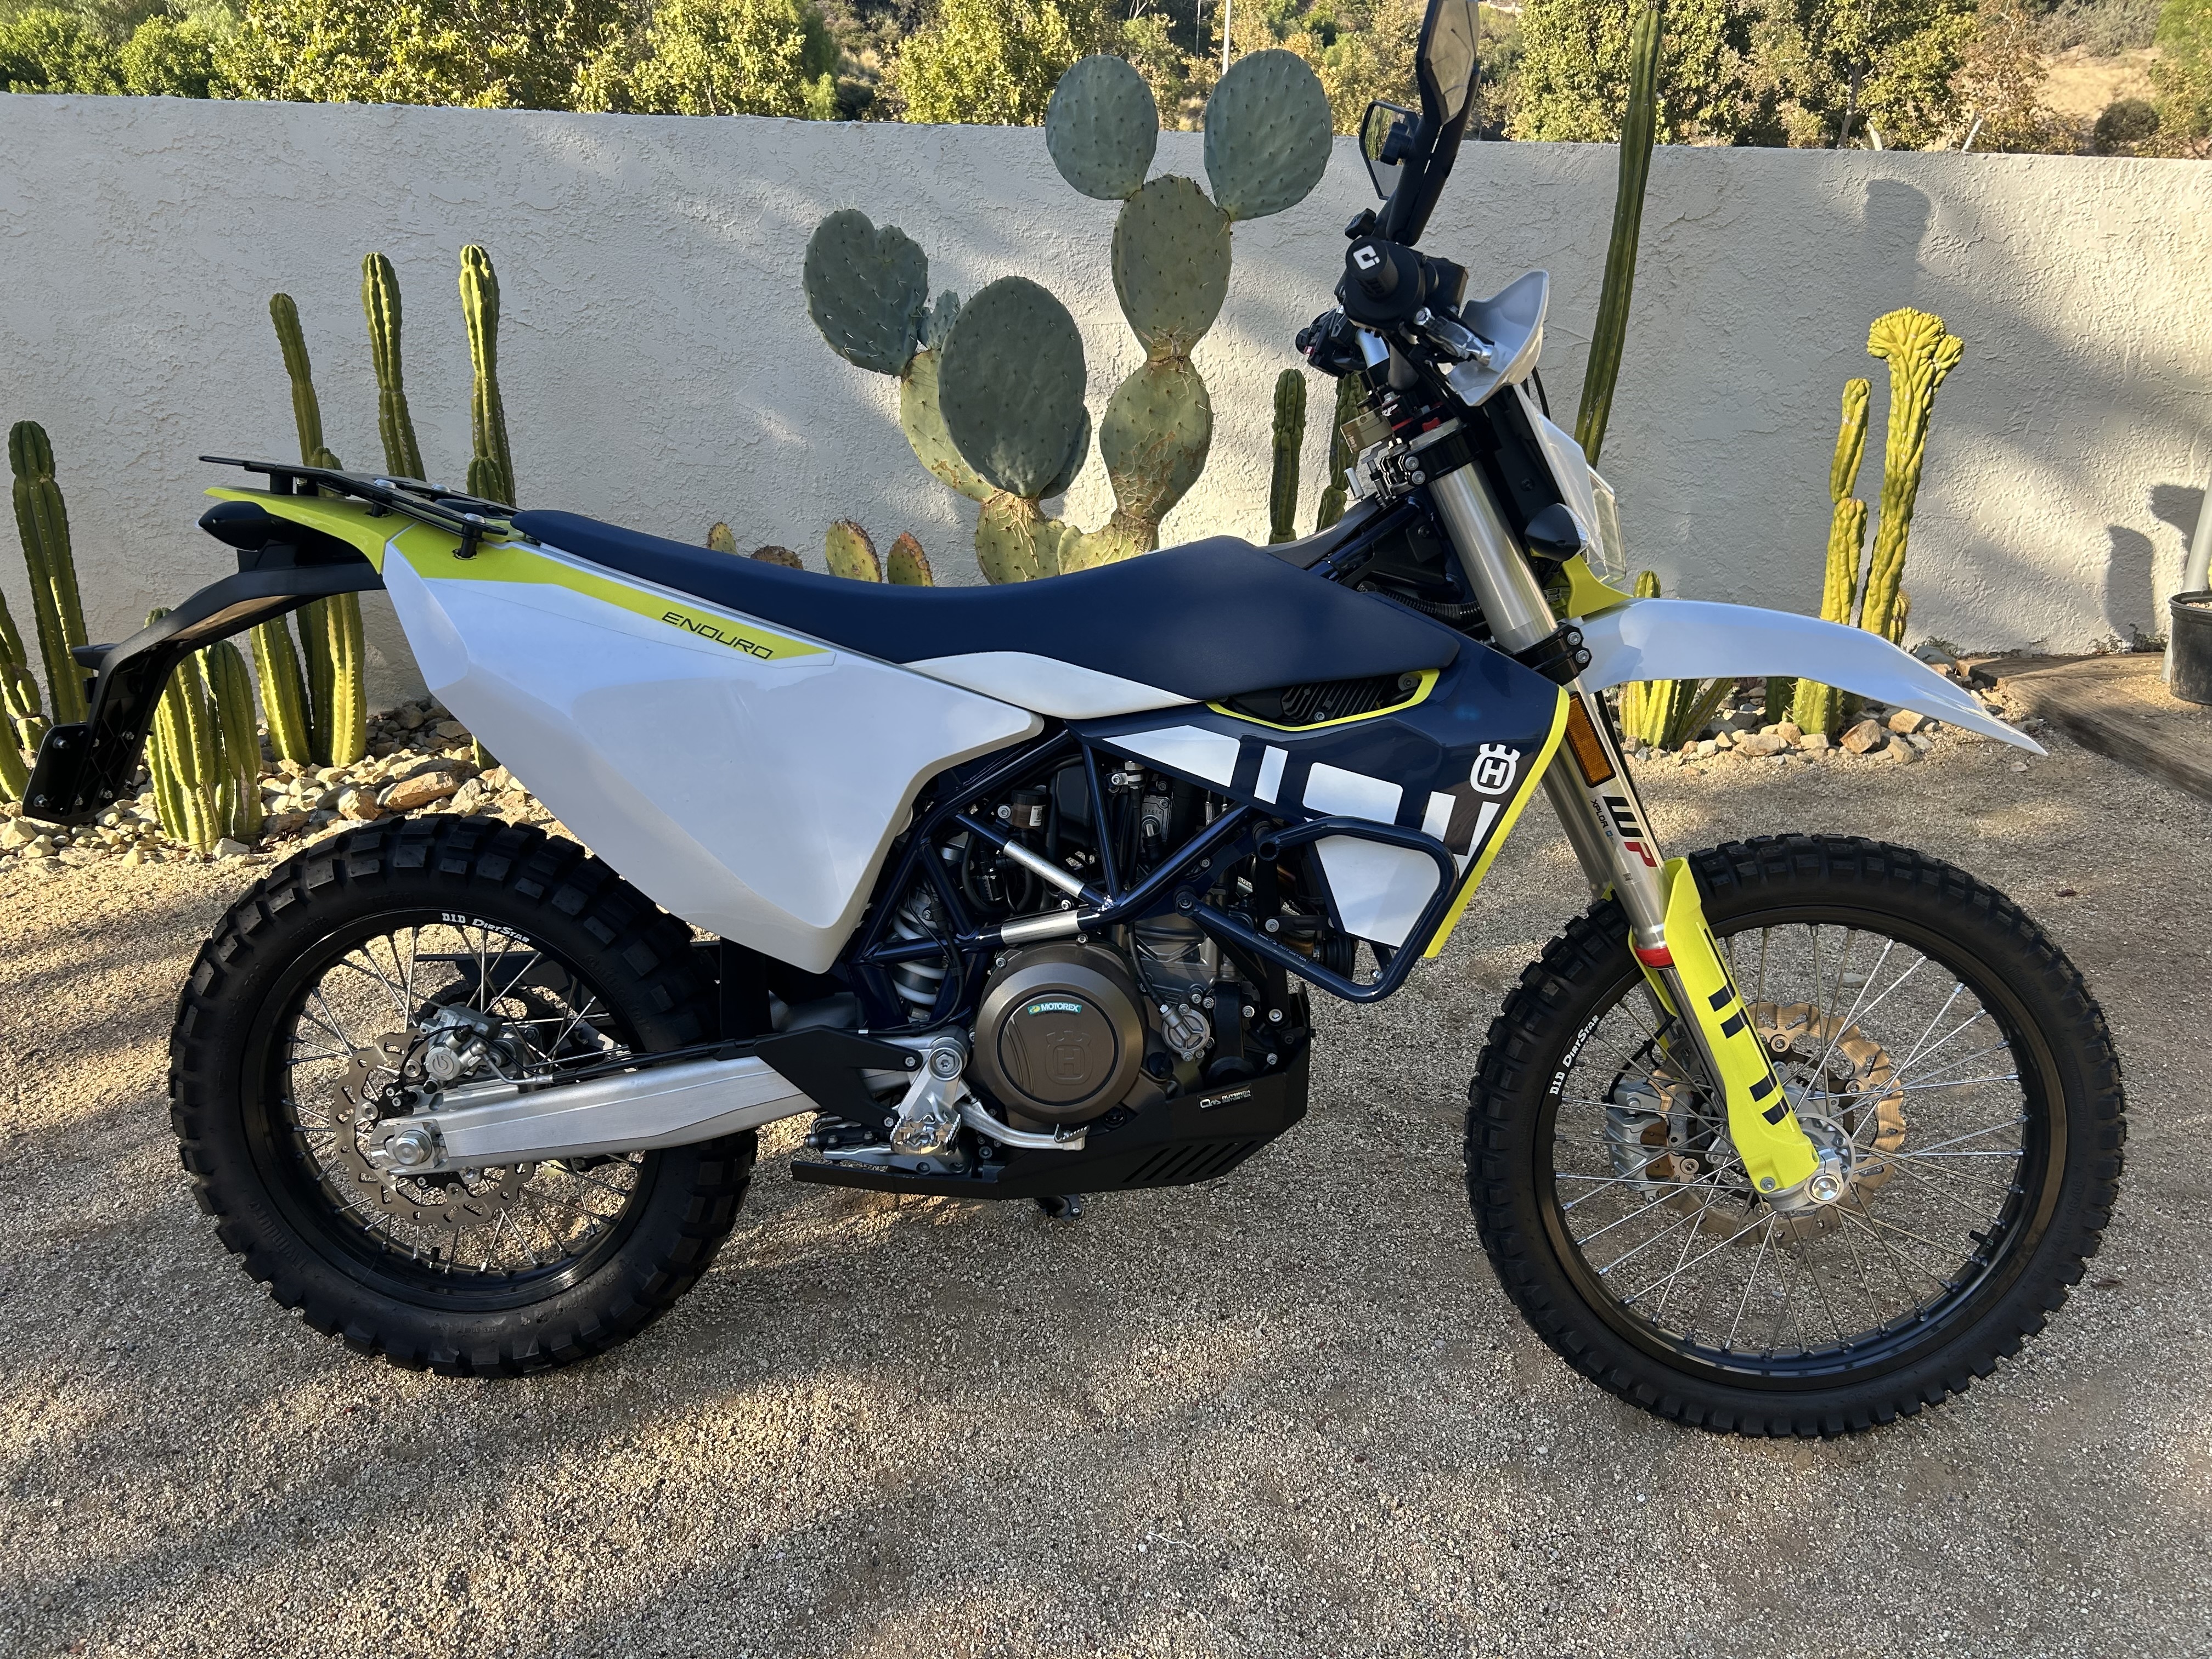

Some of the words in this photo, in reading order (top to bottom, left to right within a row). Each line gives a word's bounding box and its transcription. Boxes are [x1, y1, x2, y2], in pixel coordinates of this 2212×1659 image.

[661, 611, 774, 661] ENDURO
[1590, 799, 1609, 829] XPLOR
[442, 913, 466, 924] D.I.D
[1041, 1002, 1079, 1012] MOTOREX
[1549, 1071, 1565, 1095] D.I.D
